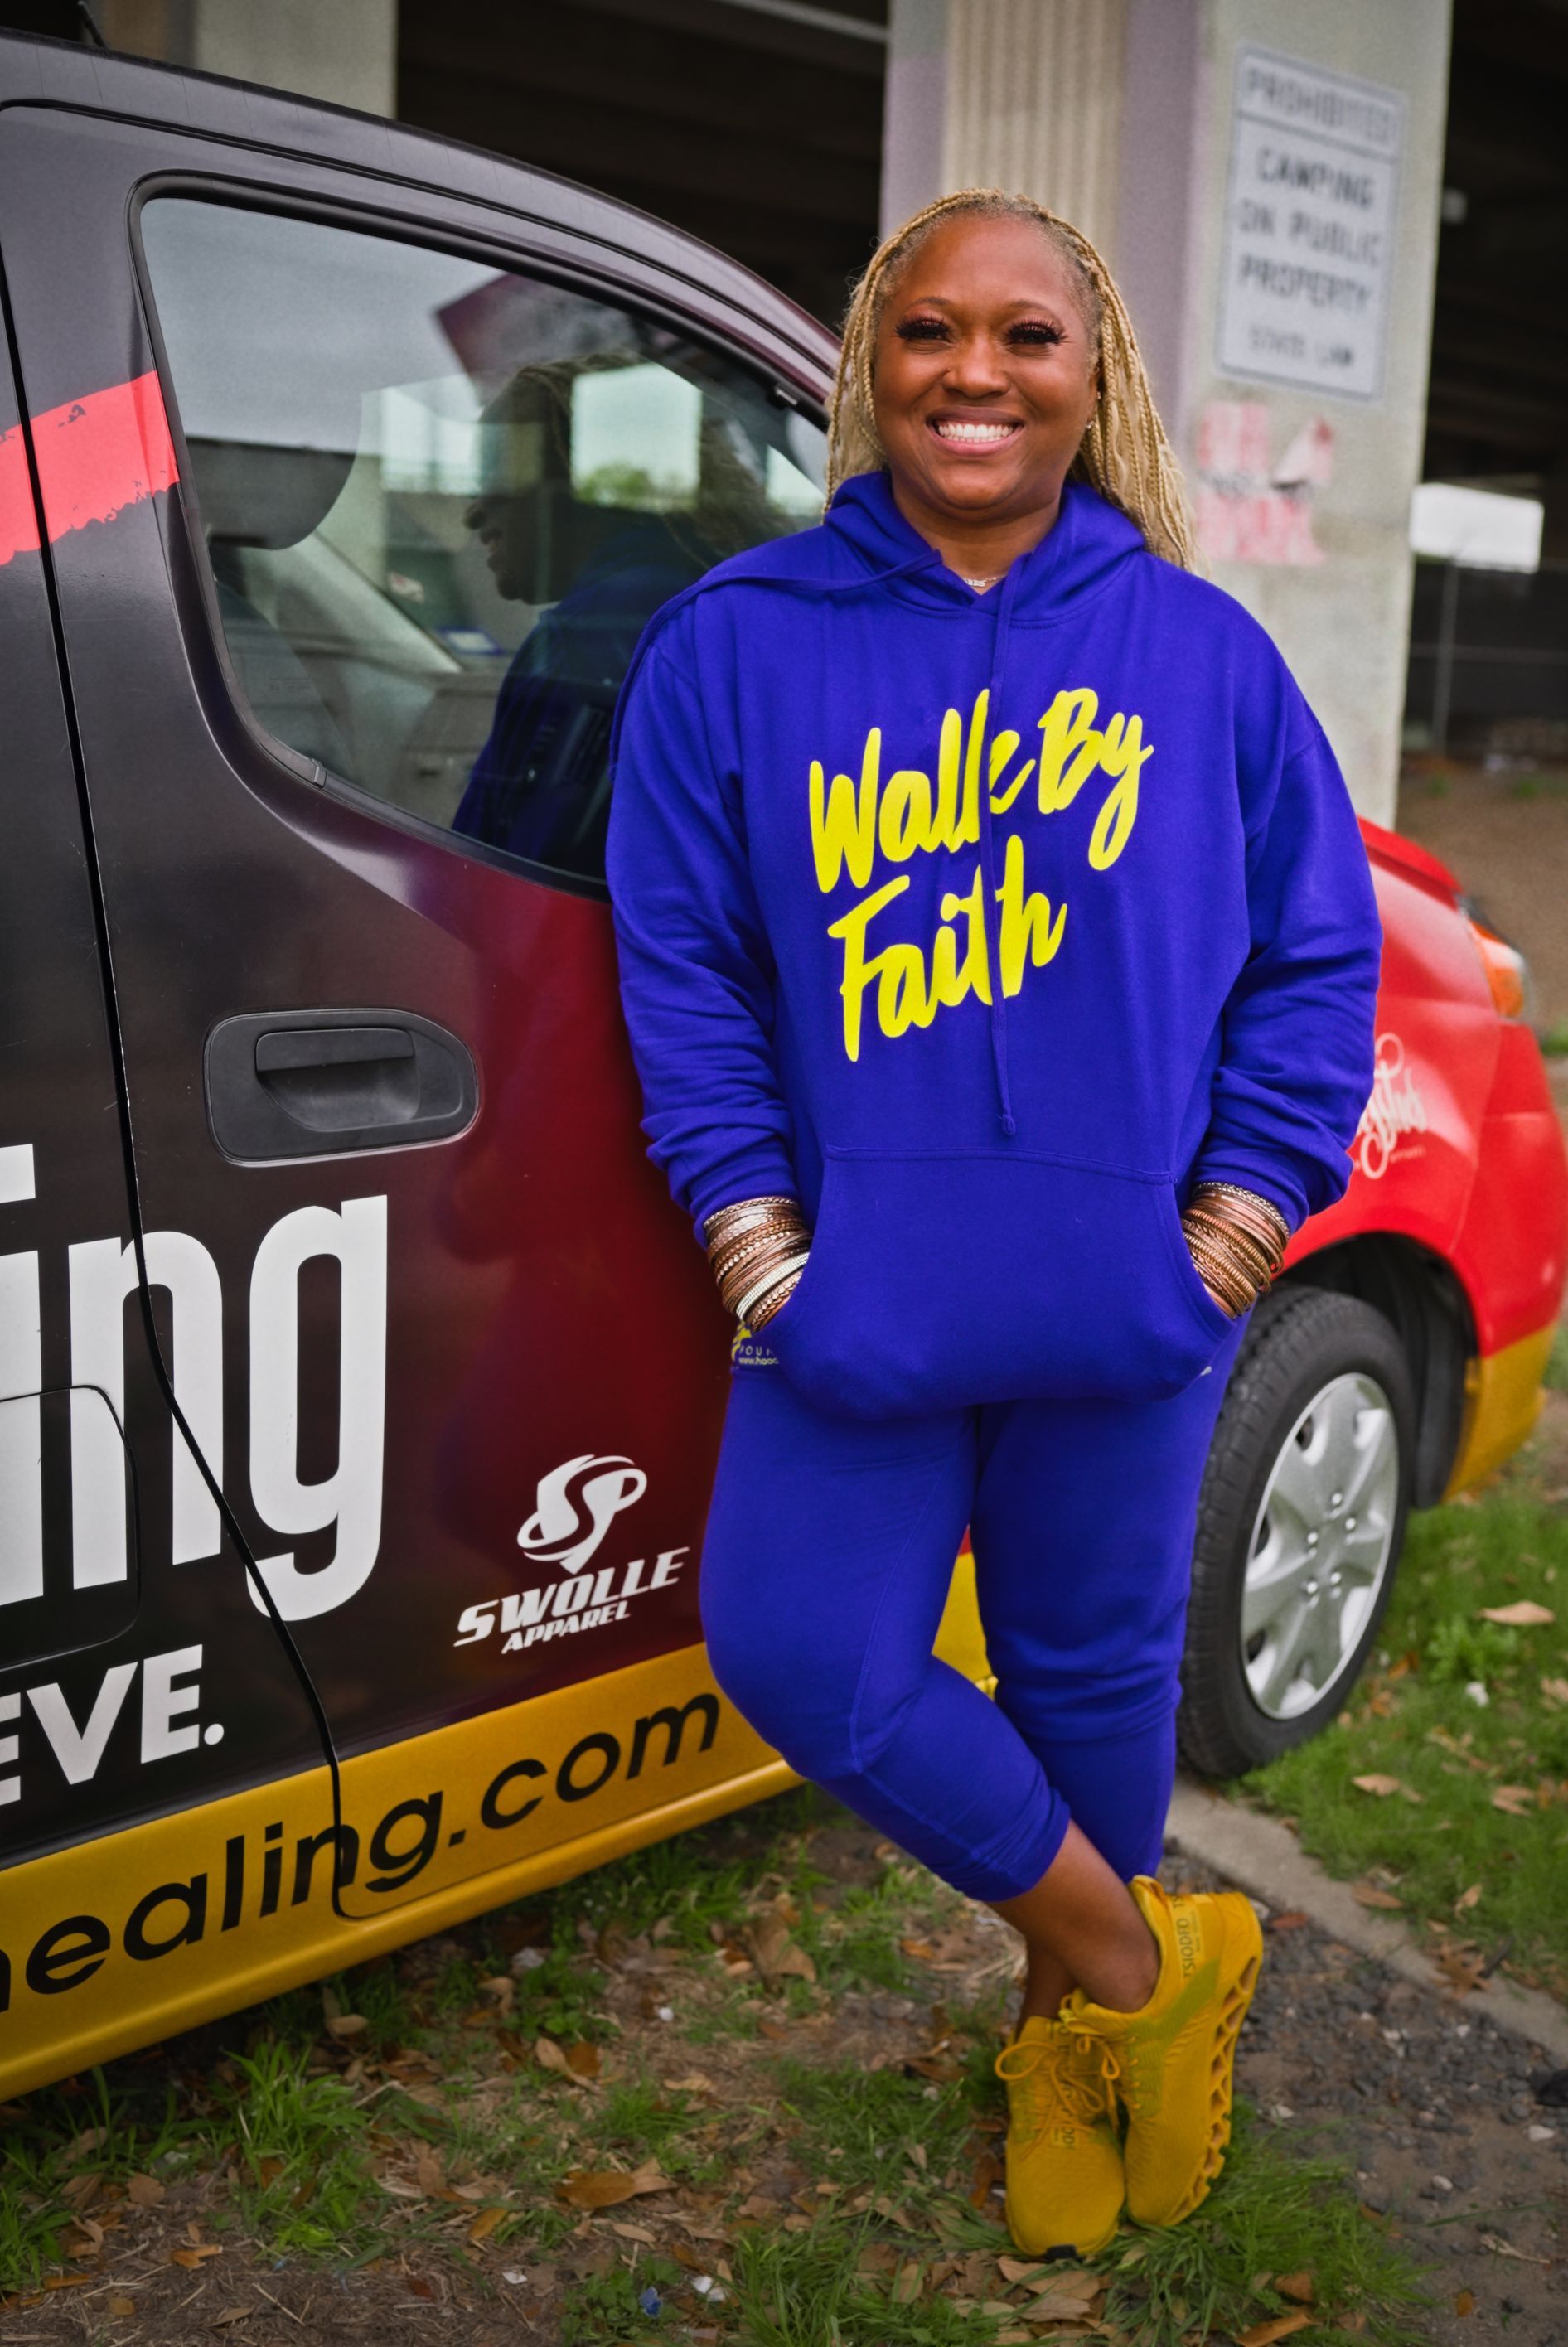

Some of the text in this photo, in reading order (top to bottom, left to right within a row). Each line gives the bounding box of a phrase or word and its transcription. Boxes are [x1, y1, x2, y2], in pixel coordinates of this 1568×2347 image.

[1255, 145, 1374, 210] CAMPING
[1238, 196, 1382, 269] ON PUBLIC
[1238, 251, 1372, 314] PROPERTY
[809, 687, 1154, 893] Walk By
[827, 835, 1068, 1062] Faith
[453, 1546, 690, 1647] SWOLLE
[501, 1600, 631, 1654] APPAREL
[0, 1693, 719, 2013] ealing.com
